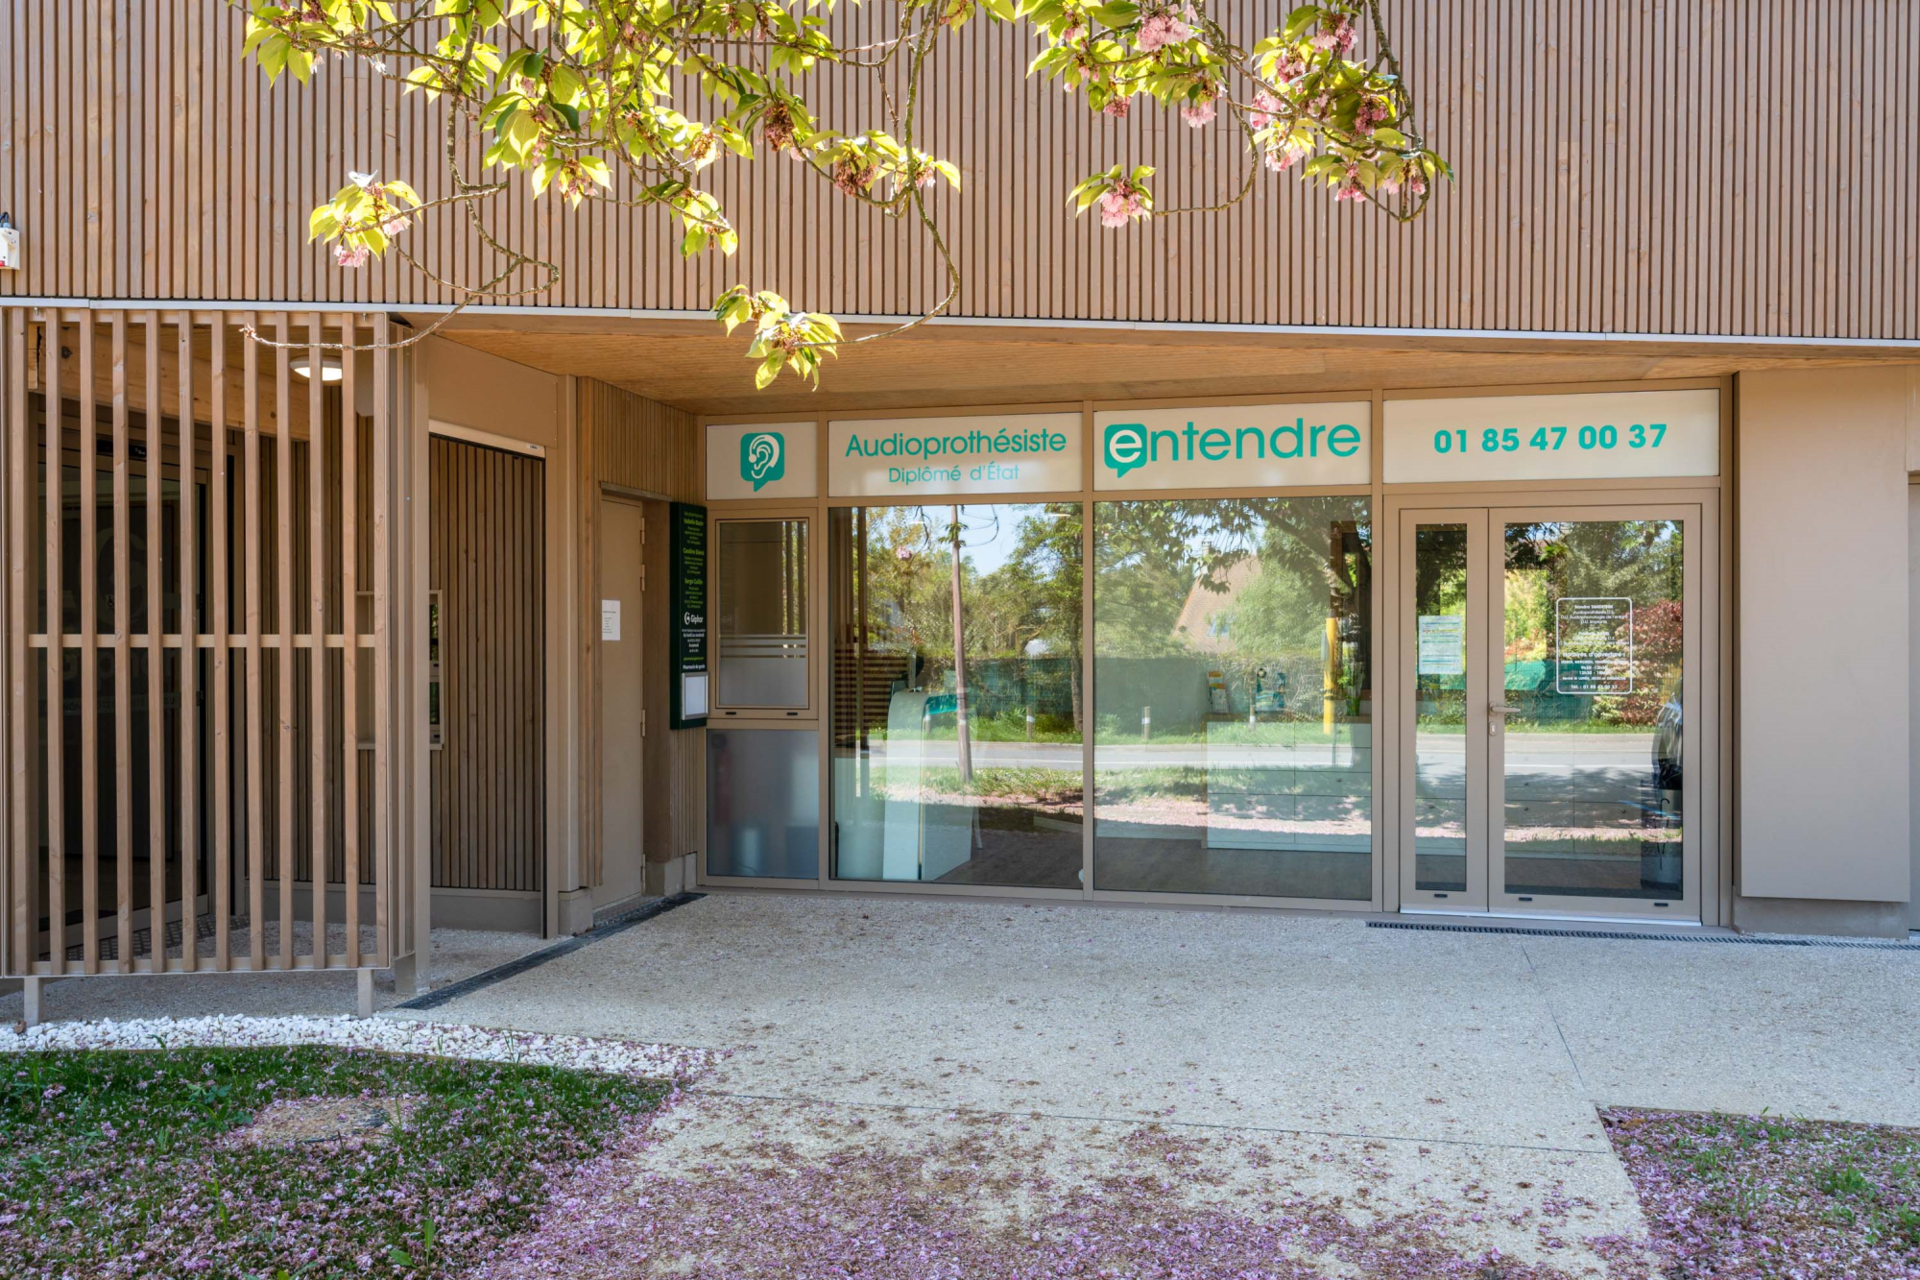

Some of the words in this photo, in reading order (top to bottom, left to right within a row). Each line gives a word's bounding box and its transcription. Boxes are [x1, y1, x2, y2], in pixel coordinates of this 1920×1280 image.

[845, 428, 1067, 459] Audioprothésiste
[1107, 417, 1362, 463] entendre
[1434, 430, 1468, 454] 01
[1481, 428, 1520, 453] 85
[1529, 426, 1567, 451] 47
[1578, 424, 1618, 450] 00
[1628, 423, 1667, 449] 37
[888, 464, 961, 486] Diplômé
[969, 460, 1019, 481] d'État
